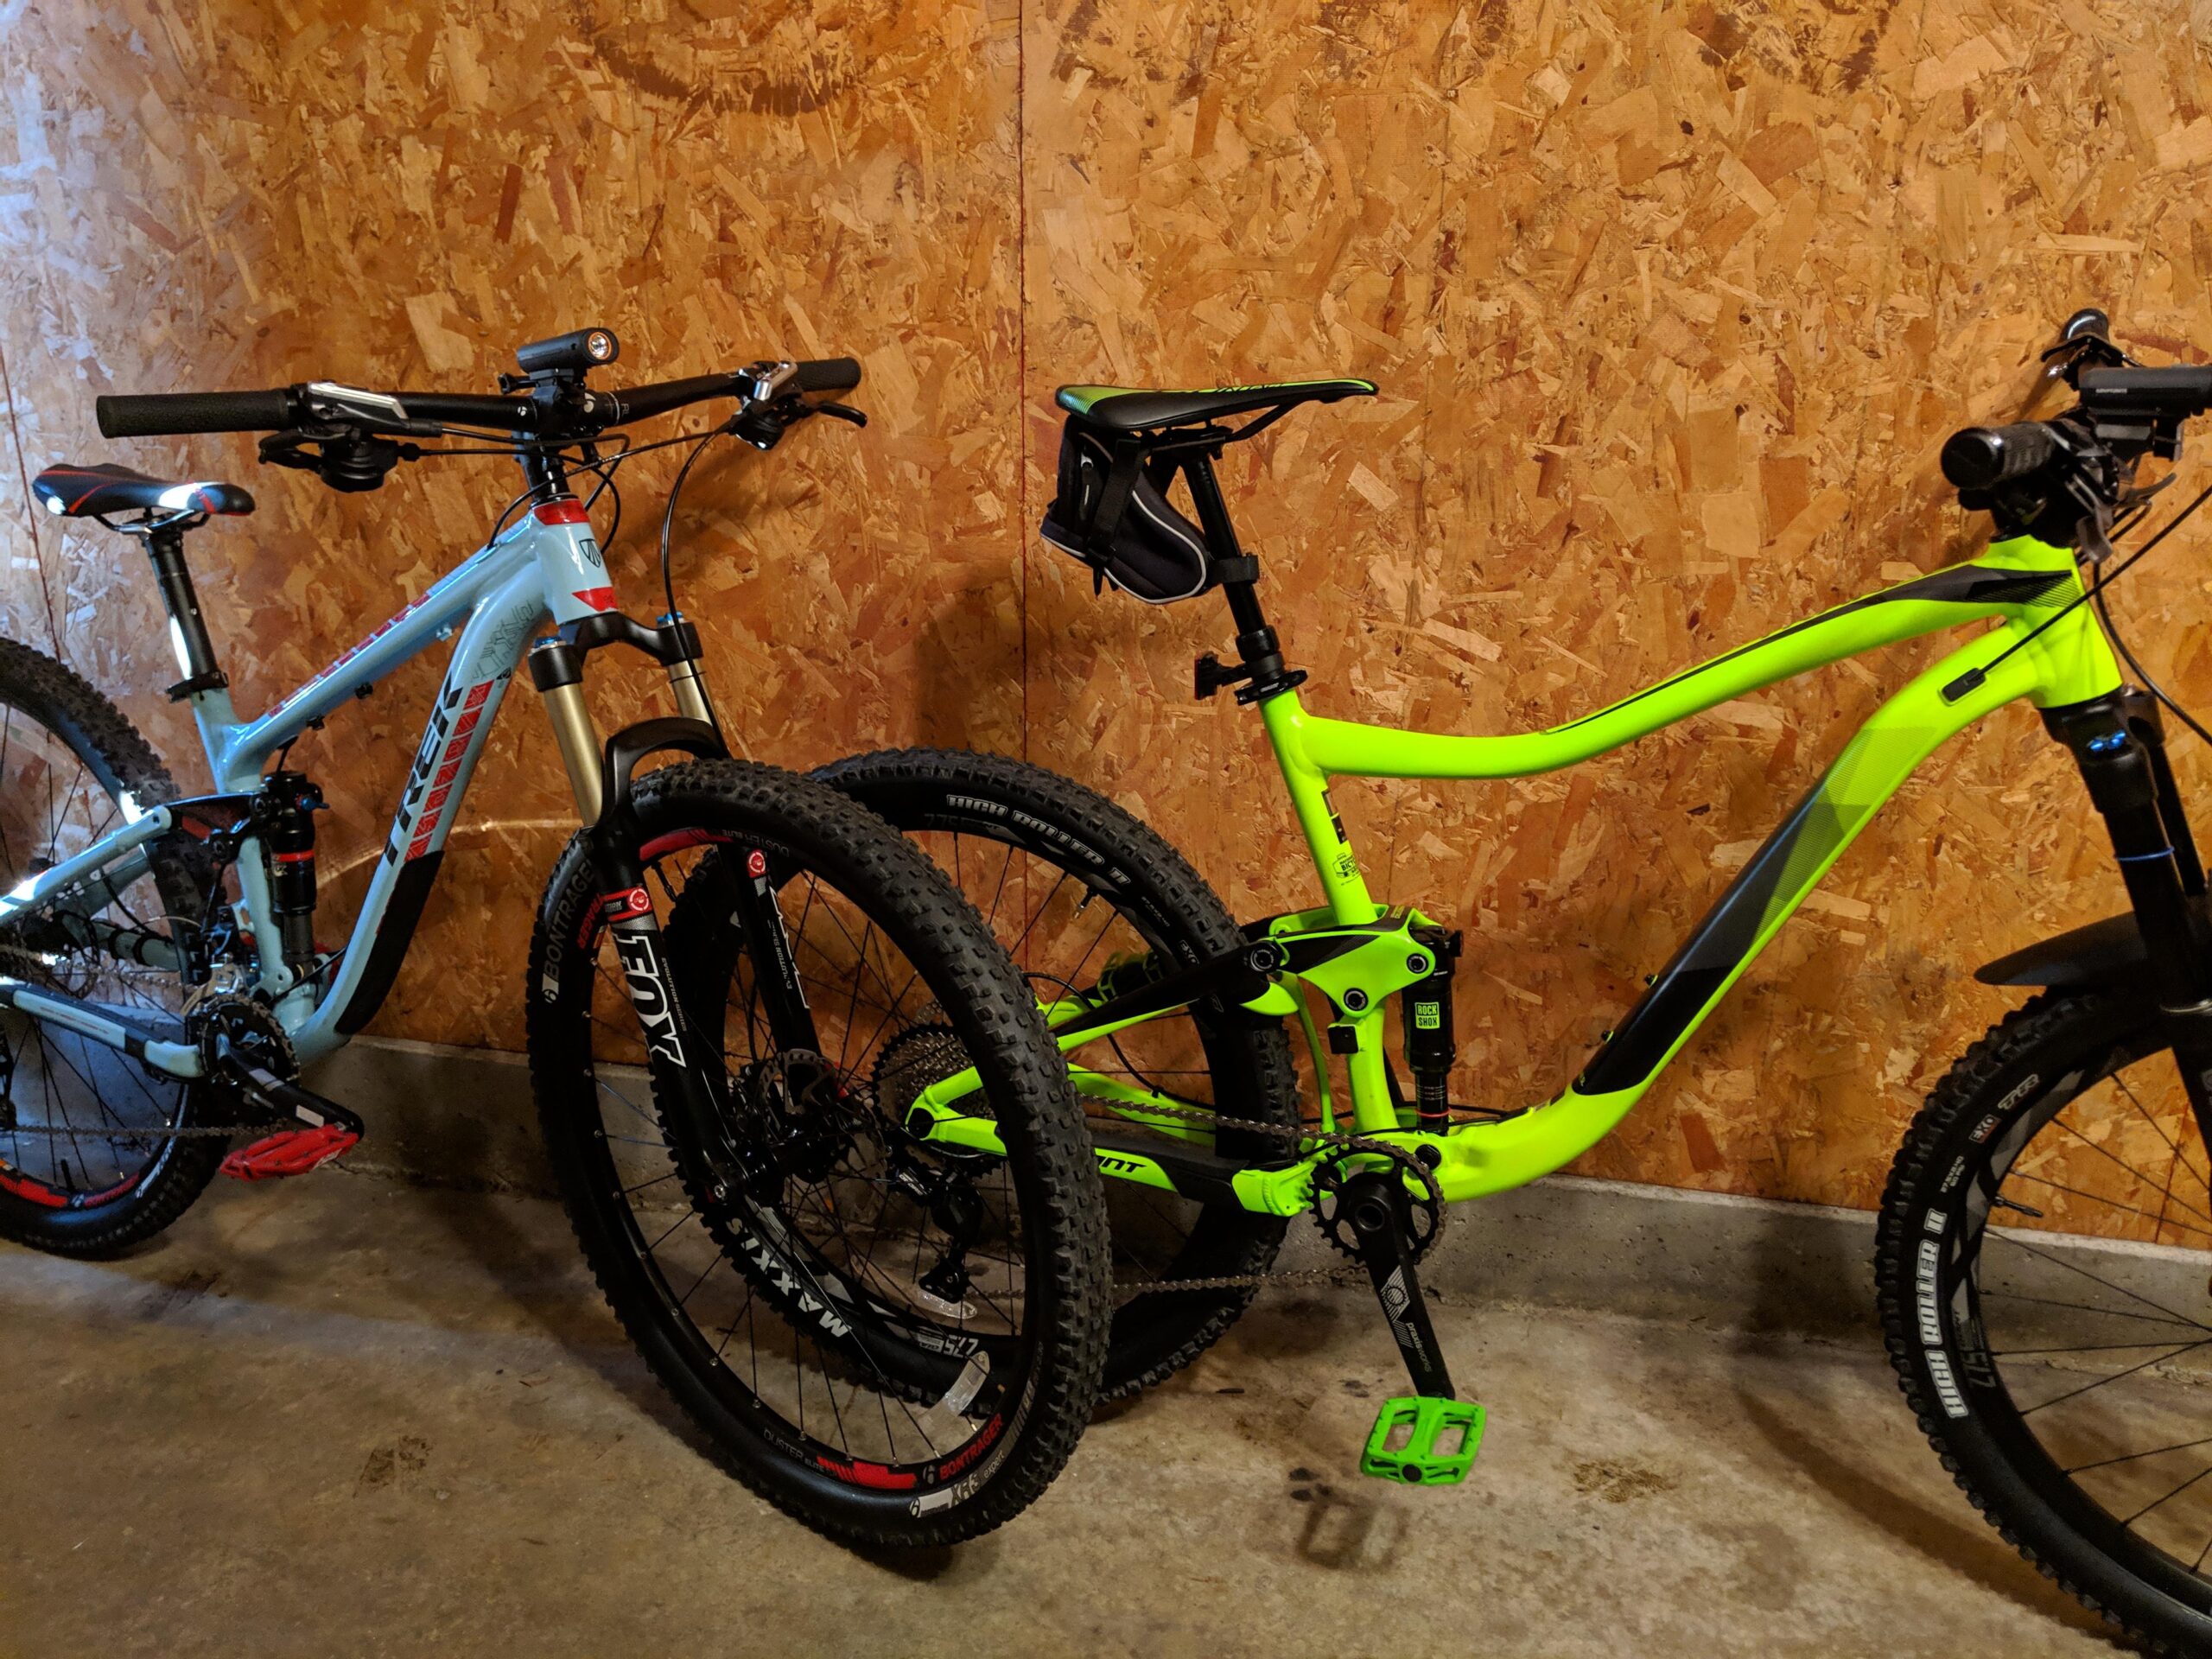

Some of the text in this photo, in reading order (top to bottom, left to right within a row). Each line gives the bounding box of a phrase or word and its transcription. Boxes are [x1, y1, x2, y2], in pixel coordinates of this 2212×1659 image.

[383, 671, 464, 868] TREK
[946, 793, 1009, 817] HIGH
[1012, 810, 1105, 866] ROLLER
[542, 855, 596, 983] BONTRAGE
[612, 934, 688, 1069] FOX
[1417, 1004, 1438, 1016] ROCK
[1418, 1016, 1438, 1027] SHOX
[1971, 1116, 1995, 1140] EXO
[725, 1217, 853, 1338] MAXXIS
[1916, 1238, 1942, 1345] ROLLER
[1924, 1349, 1969, 1419] HIGH
[763, 1427, 805, 1462] DUSTER
[939, 1413, 1003, 1481] BONTRAGER
[982, 1449, 1005, 1479] expert
